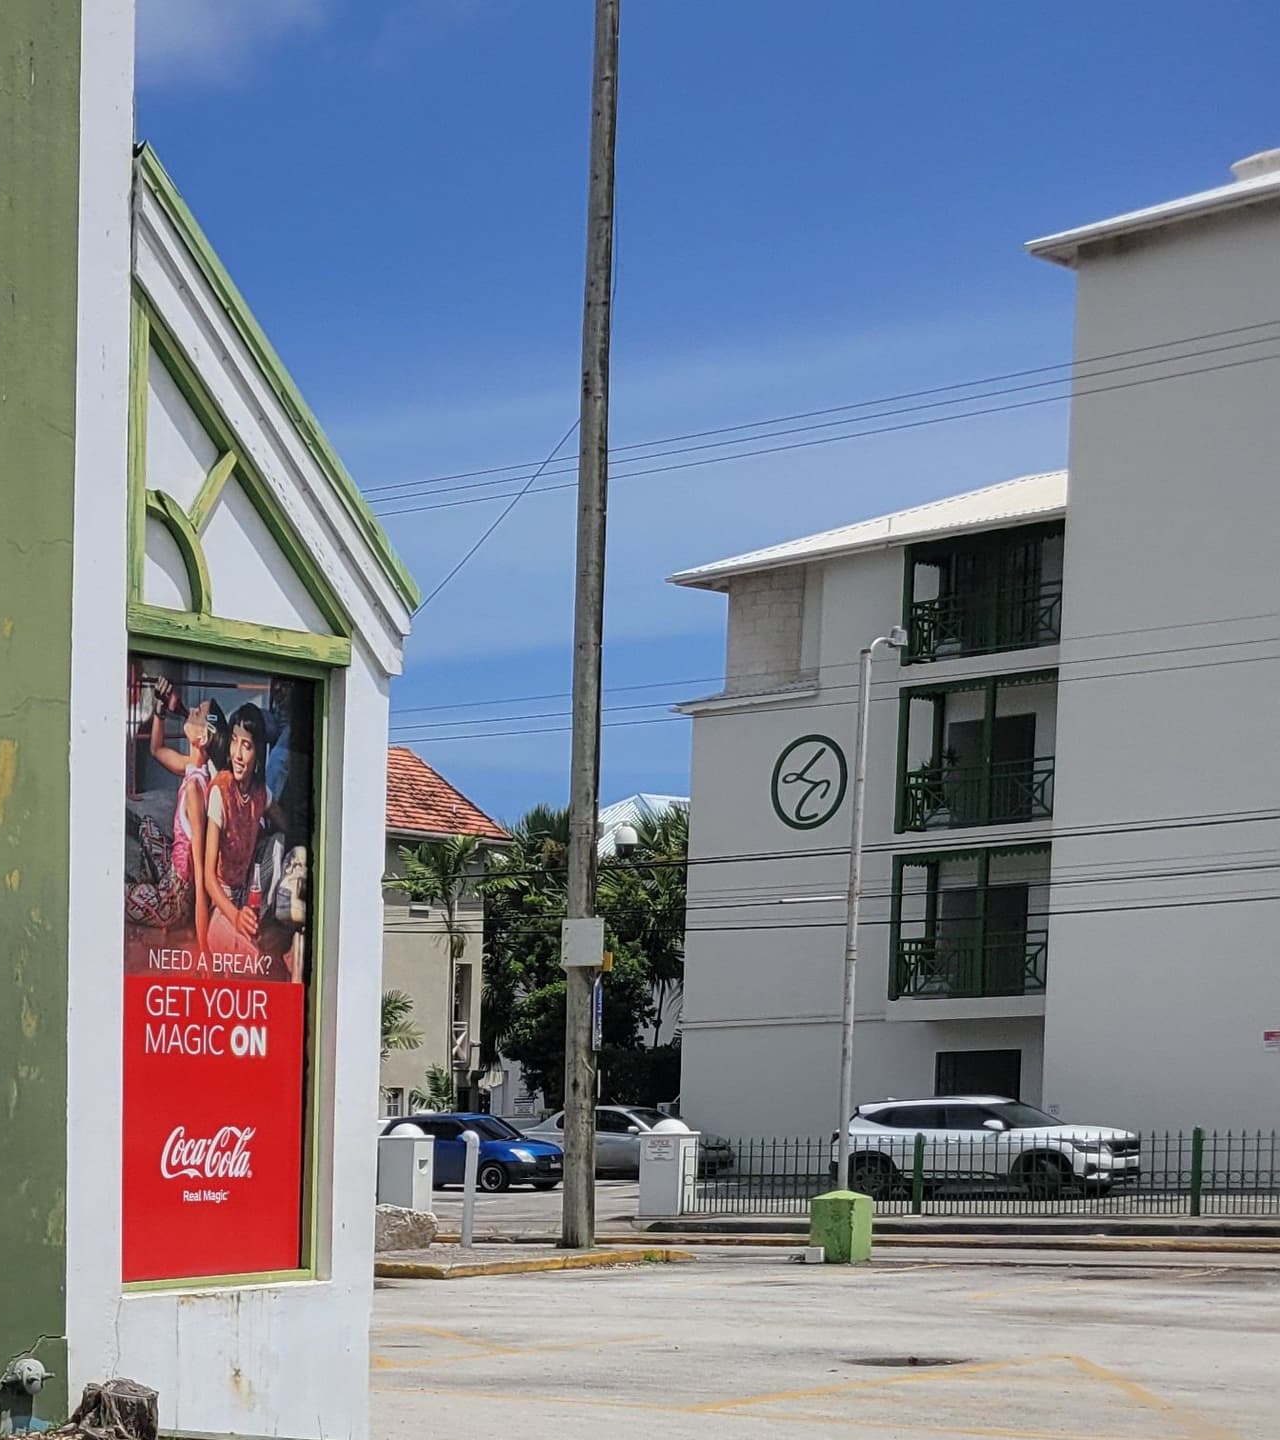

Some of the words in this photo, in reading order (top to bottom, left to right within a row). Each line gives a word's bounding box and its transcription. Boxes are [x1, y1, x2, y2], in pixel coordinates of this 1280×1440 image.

[149, 949, 192, 970] NEED
[197, 951, 208, 972] A
[213, 952, 272, 975] BREAK?
[146, 985, 195, 1017] GET
[201, 987, 268, 1020] YOUR
[145, 1024, 224, 1055] MAGIC
[230, 1026, 267, 1057] ON
[161, 1126, 256, 1179] Coca-Cola
[183, 1190, 201, 1202] Real
[203, 1190, 228, 1203] Magic
